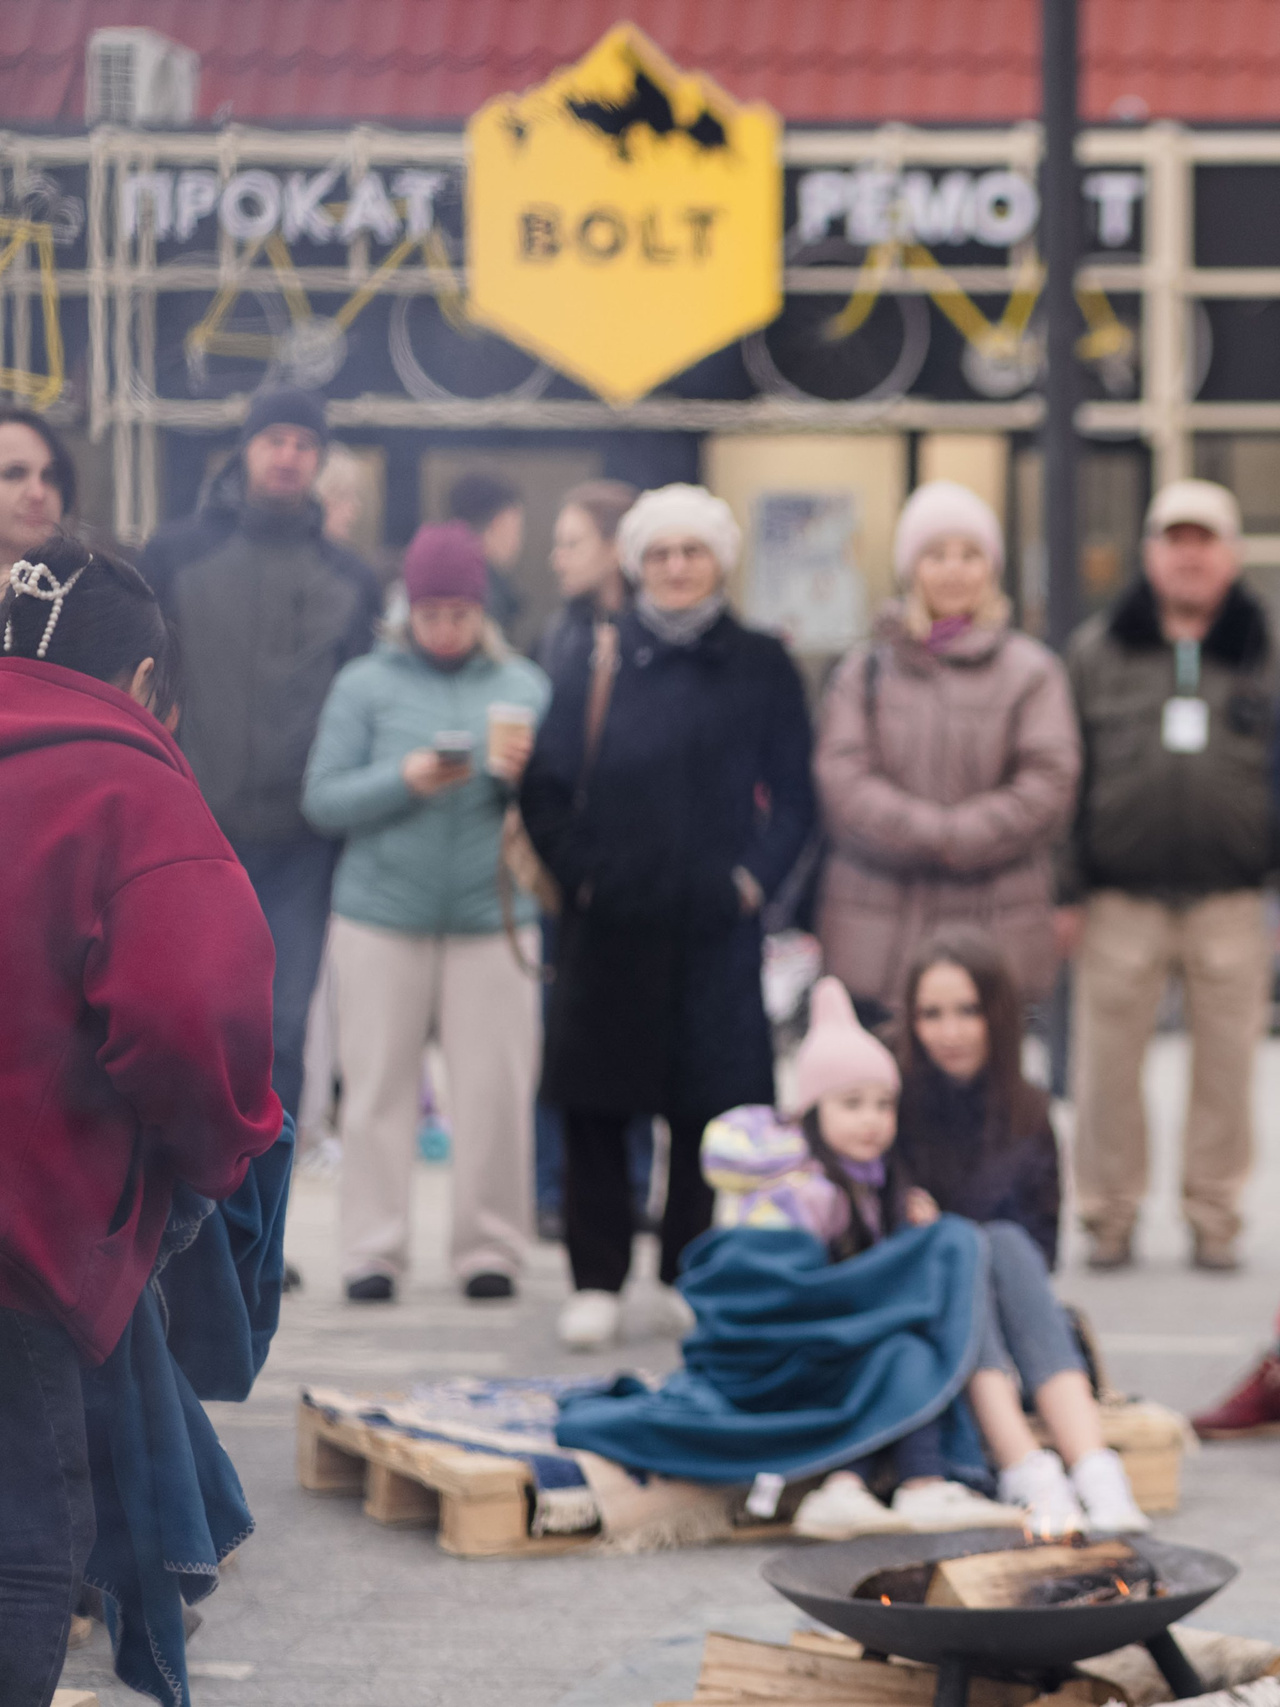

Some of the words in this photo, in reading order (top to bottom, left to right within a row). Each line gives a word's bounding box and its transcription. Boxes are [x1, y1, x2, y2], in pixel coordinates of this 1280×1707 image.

[122, 167, 446, 245] ПРОКАТ
[518, 207, 724, 264] BOLT
[797, 168, 1144, 247] РЕМОТ
